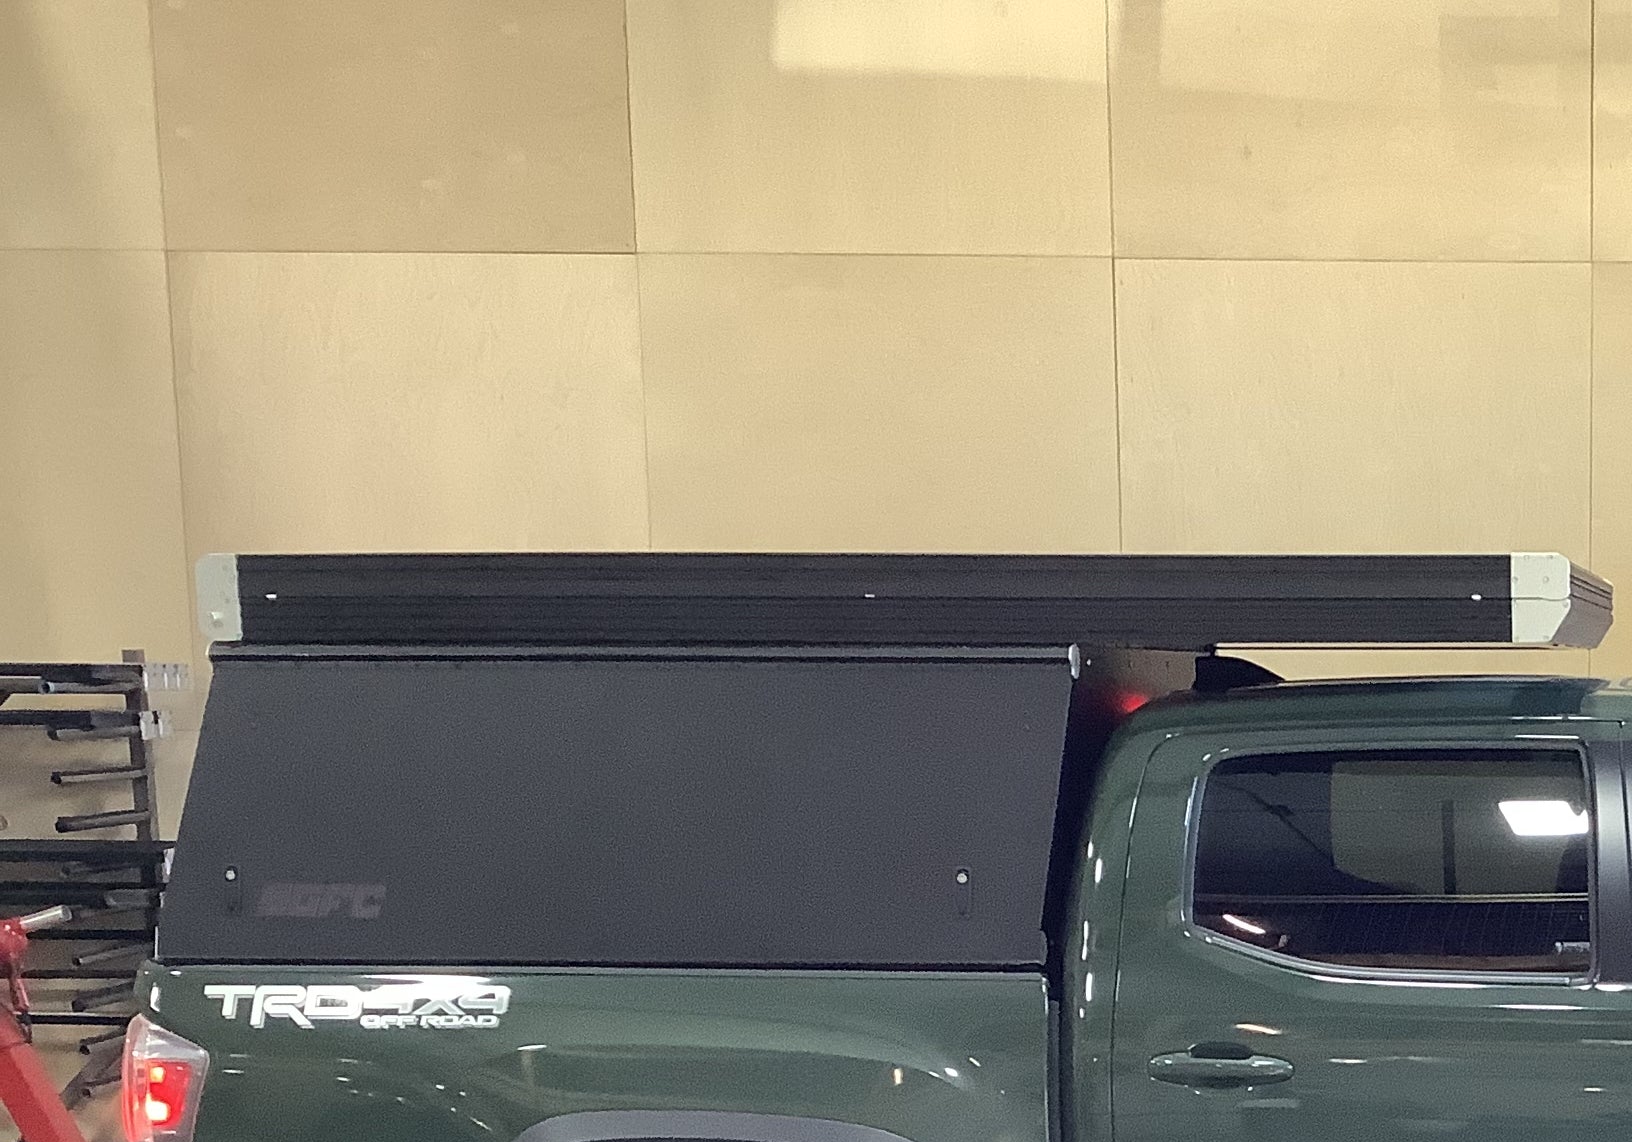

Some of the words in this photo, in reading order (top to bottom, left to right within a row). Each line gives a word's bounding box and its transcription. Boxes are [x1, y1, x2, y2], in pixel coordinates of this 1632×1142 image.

[204, 985, 362, 1028] TRD
[359, 1014, 418, 1029] OFF
[418, 1014, 500, 1029] ROAD
